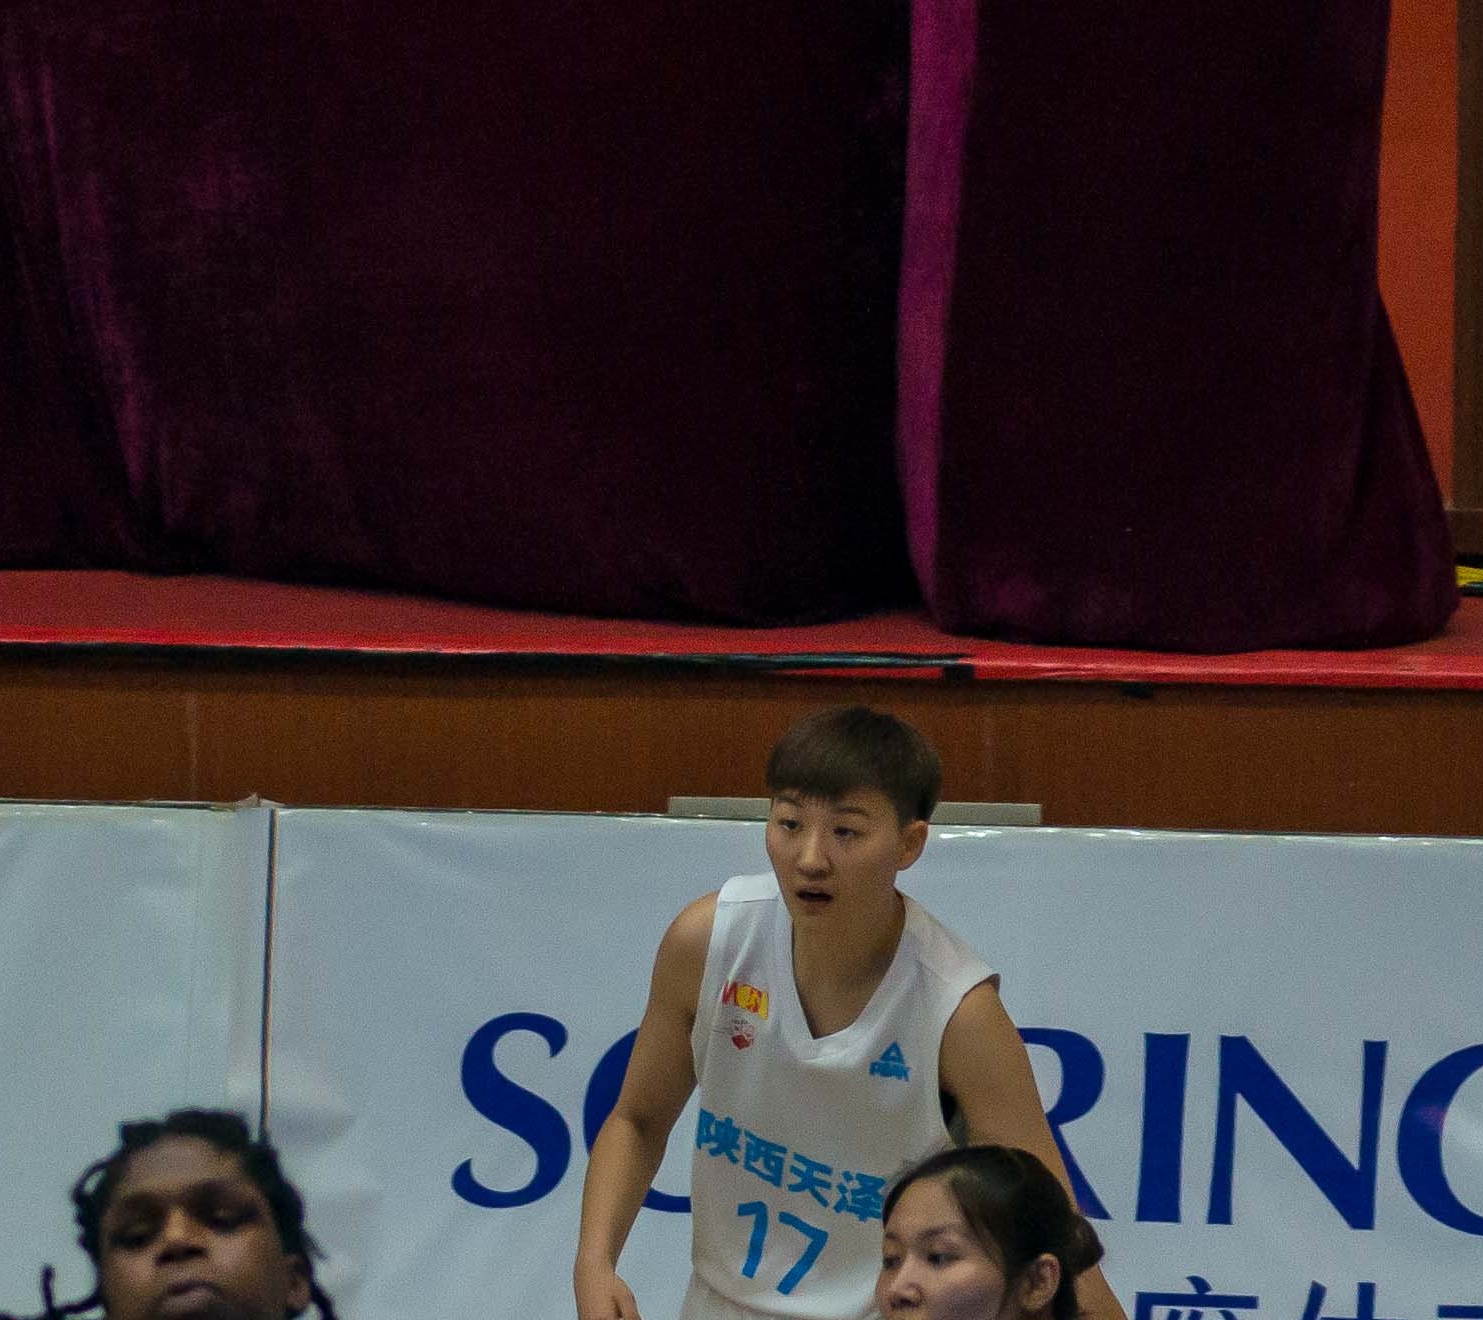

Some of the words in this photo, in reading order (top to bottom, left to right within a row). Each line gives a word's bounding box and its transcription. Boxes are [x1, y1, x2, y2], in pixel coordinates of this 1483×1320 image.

[696, 1107, 886, 1222] 陕西天泽
[737, 1200, 829, 1296] 17
